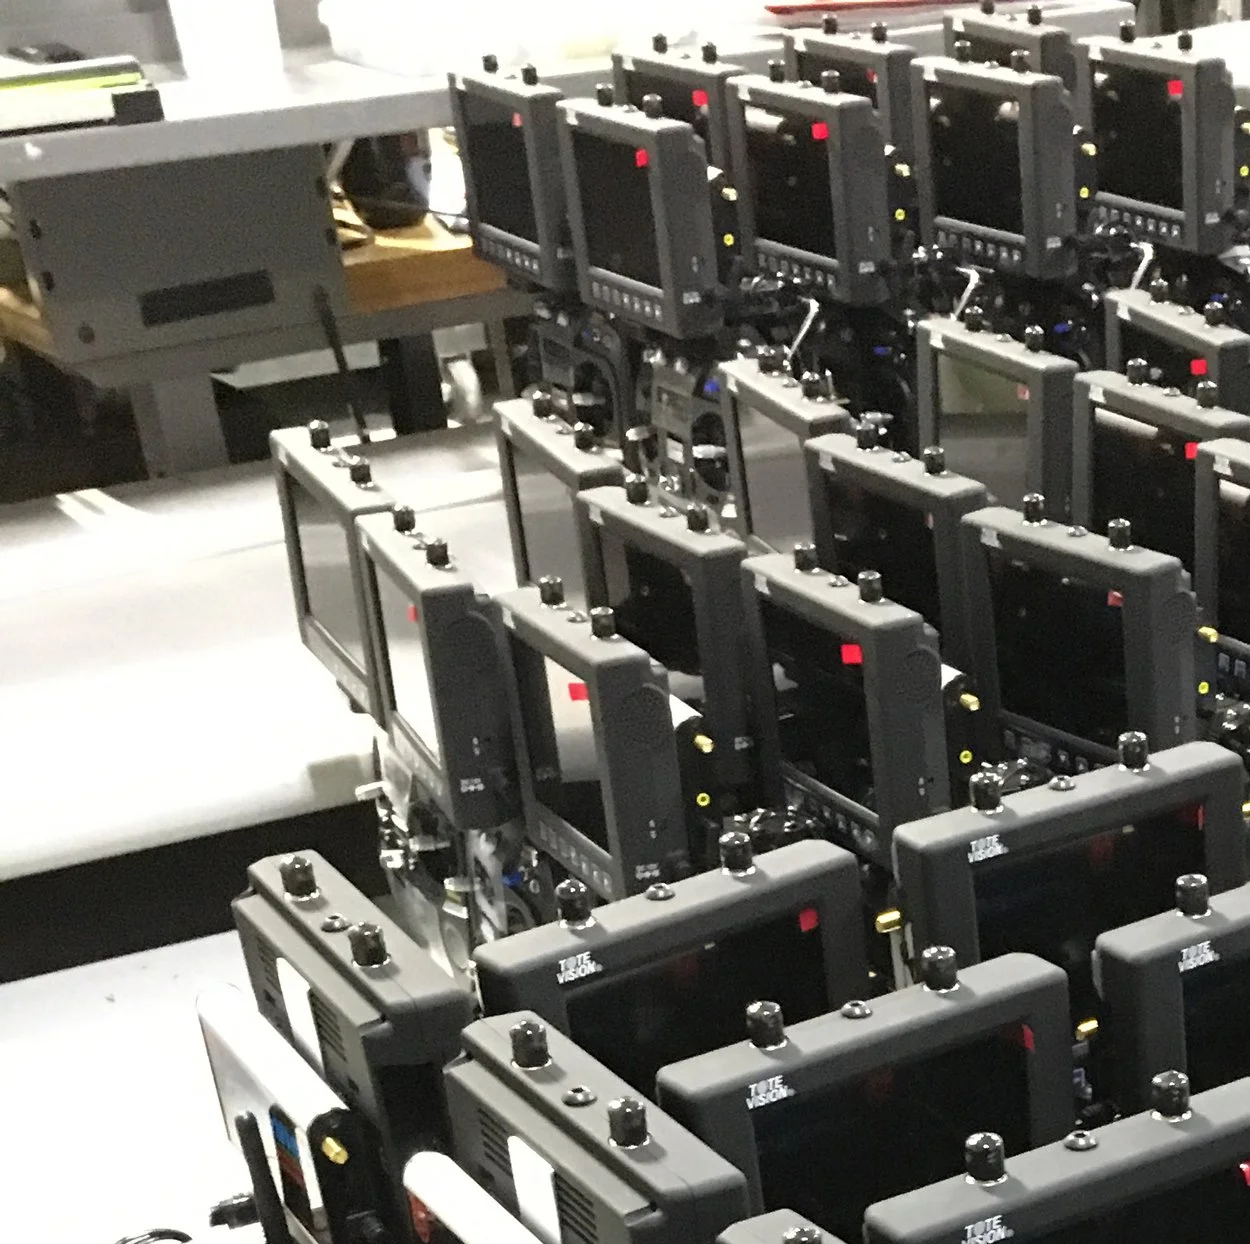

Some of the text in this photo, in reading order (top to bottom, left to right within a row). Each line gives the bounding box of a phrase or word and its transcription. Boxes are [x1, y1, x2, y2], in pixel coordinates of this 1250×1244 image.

[558, 951, 591, 971] TOTE
[749, 1075, 784, 1098] TOTE
[964, 1215, 1003, 1239] TOTE
